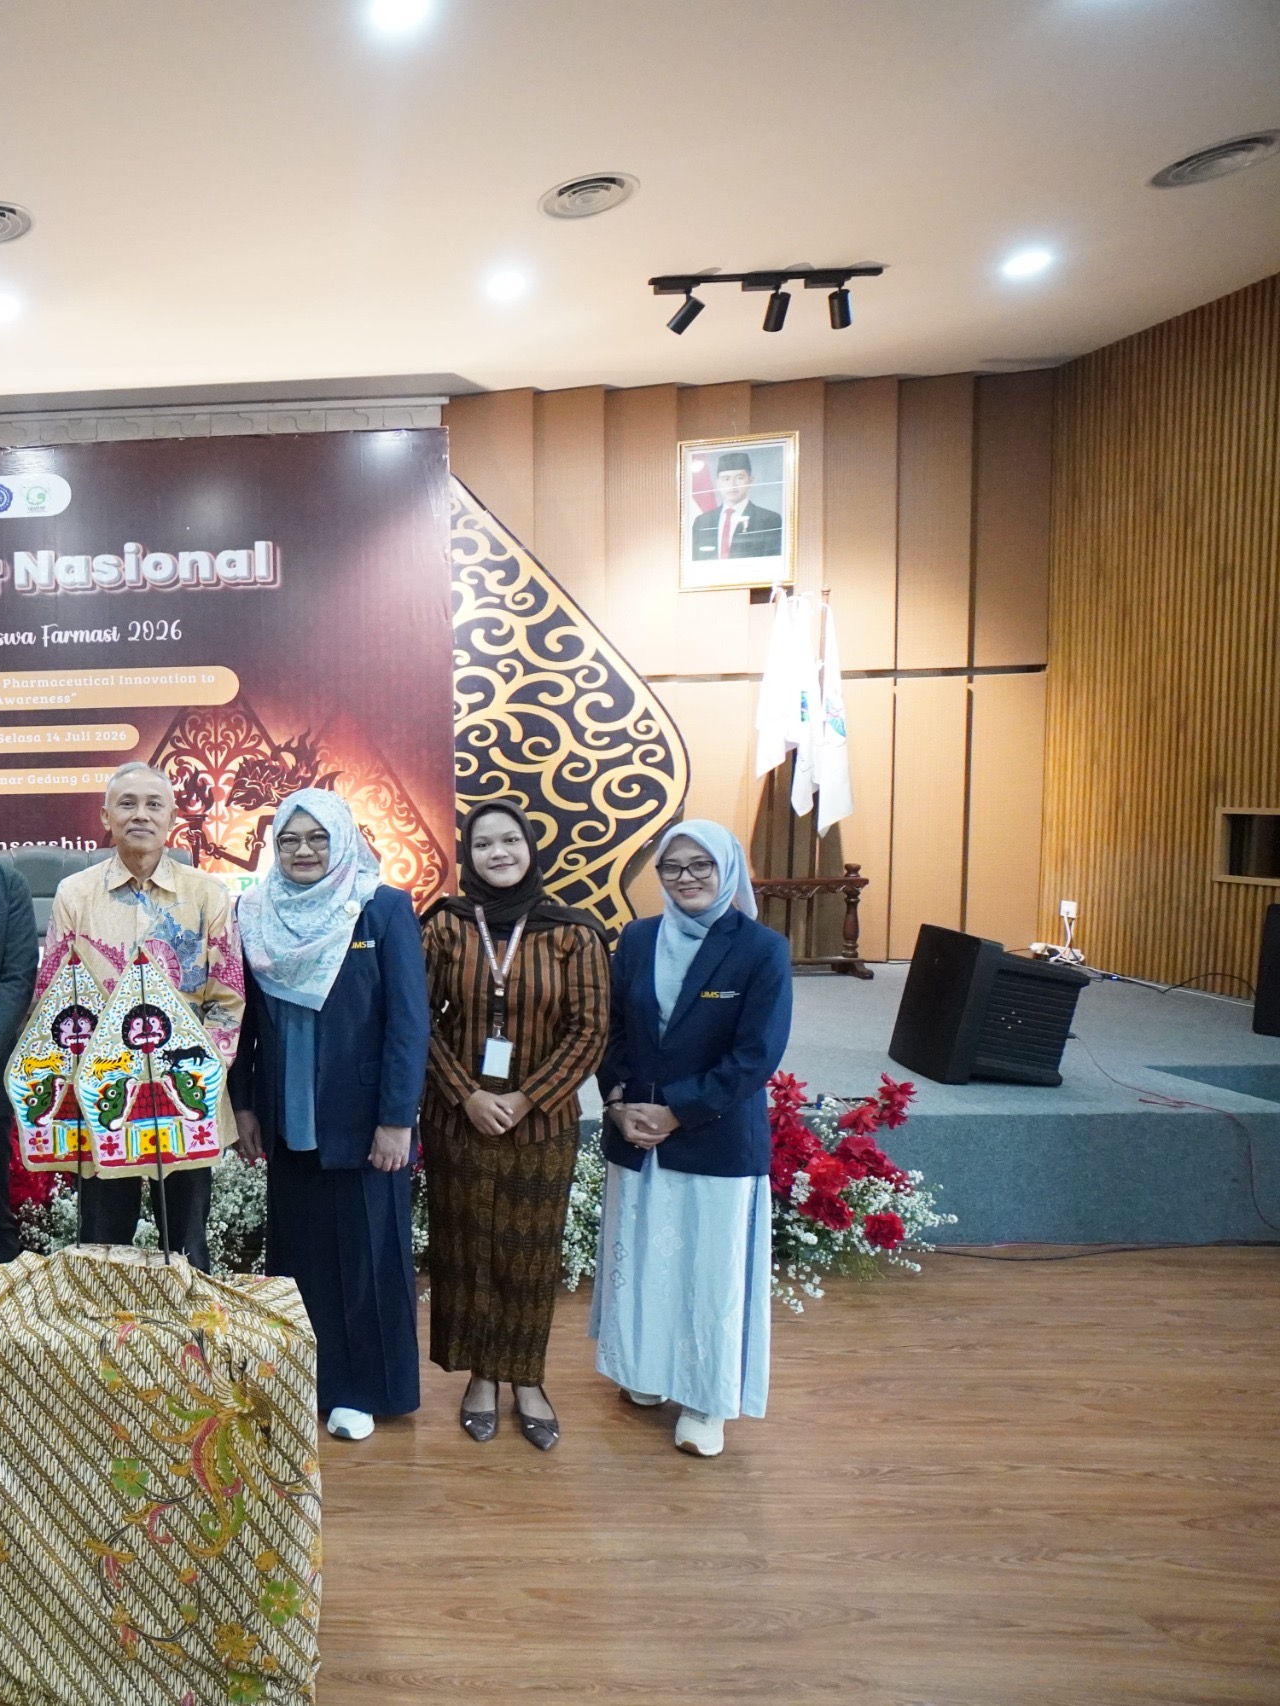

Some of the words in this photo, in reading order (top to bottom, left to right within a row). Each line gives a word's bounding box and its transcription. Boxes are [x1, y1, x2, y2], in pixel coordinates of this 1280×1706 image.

[14, 541, 276, 592] Nasional
[41, 623, 120, 648] Farmasi
[127, 619, 183, 641] 2026
[2, 674, 115, 689] Pharmaceutical
[119, 673, 197, 686] Innovation
[201, 673, 216, 684] to
[45, 732, 61, 743] 14
[64, 730, 91, 742] Juli
[95, 730, 127, 742] 2026
[27, 774, 78, 786] Gedung
[81, 773, 91, 784] G
[95, 772, 116, 783] UM
